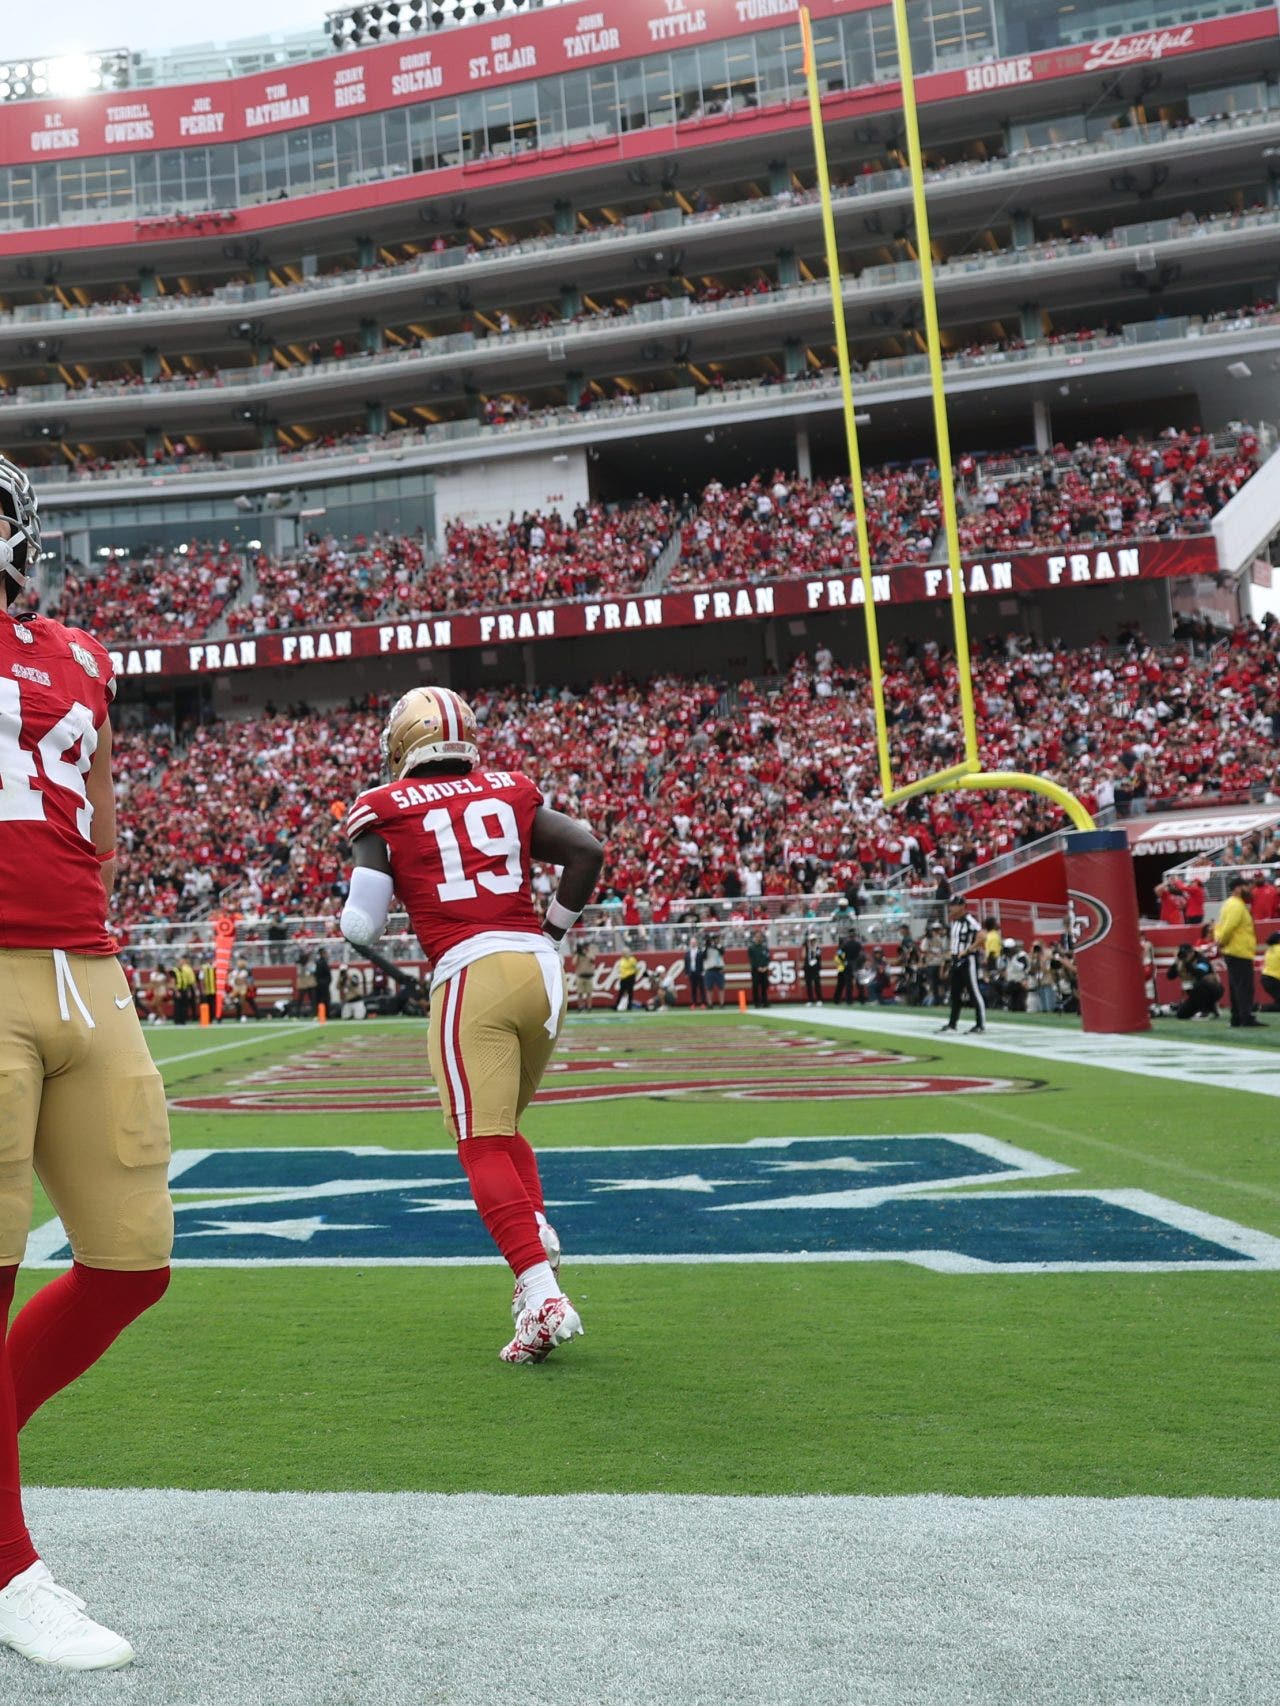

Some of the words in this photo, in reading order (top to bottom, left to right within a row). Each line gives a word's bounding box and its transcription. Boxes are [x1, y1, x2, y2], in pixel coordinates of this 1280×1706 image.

[576, 13, 604, 32] JOHN
[648, 8, 707, 42] TITTLE
[735, 0, 799, 22] TURNER
[563, 28, 620, 58] TAYLOR
[469, 53, 493, 79] ST.
[495, 45, 537, 74] CLAIR
[965, 57, 1034, 92] HOME
[1084, 27, 1195, 71] Faithful
[335, 84, 366, 108] RICE
[392, 66, 442, 96] SOLTAU
[180, 113, 225, 136] PERRY
[245, 96, 310, 127] RATHMAN
[31, 128, 79, 151] OWENS
[104, 120, 154, 144] OWENS
[109, 649, 162, 675] RAN
[189, 641, 256, 670] FRAN
[282, 631, 352, 661] FRAN
[379, 620, 451, 652] FRAN
[480, 610, 555, 642] FRAN
[584, 599, 662, 632] FRAN
[694, 586, 774, 620] FRAN
[807, 574, 891, 609] FRAN
[1048, 548, 1140, 584] FRAN
[391, 778, 483, 810] SAMUEL
[483, 771, 516, 790] SR
[422, 797, 523, 902] 19
[767, 960, 797, 985] 35
